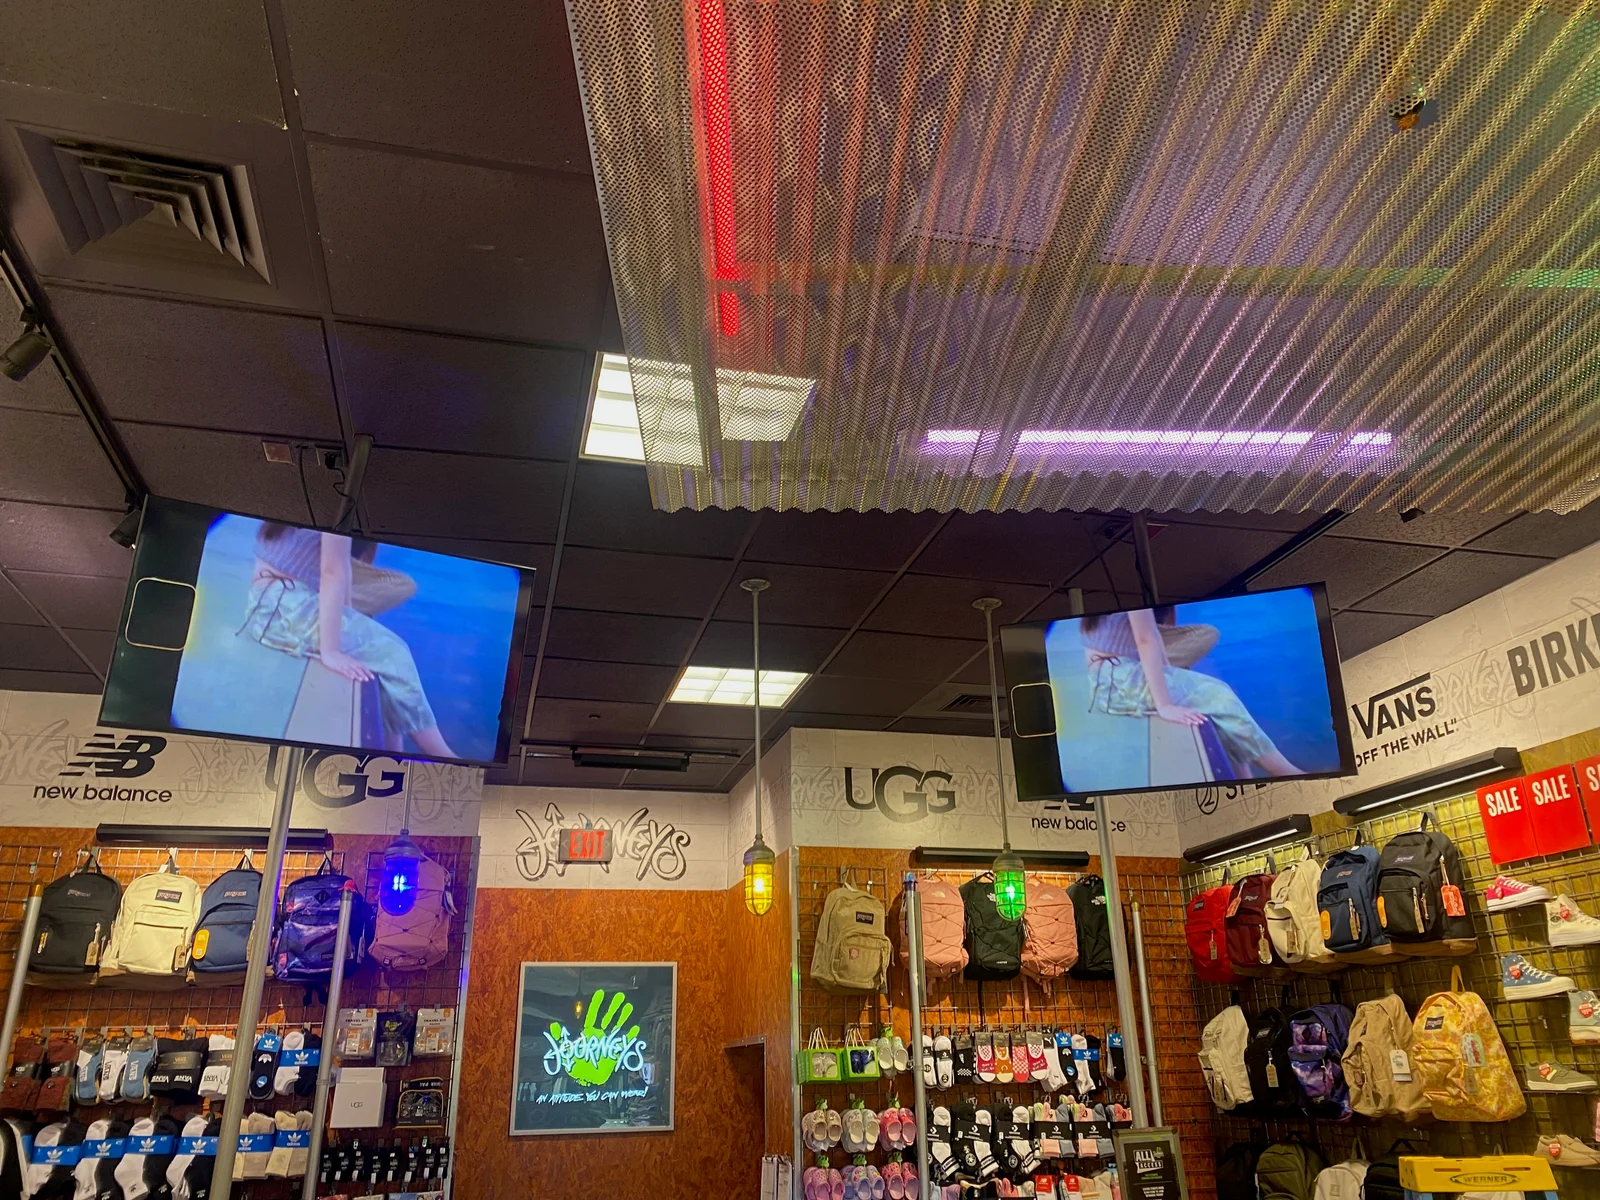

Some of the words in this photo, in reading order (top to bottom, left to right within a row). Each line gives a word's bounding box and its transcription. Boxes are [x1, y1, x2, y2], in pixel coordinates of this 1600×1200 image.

[1351, 672, 1436, 740] VANS
[1381, 737, 1410, 758] THE
[1532, 774, 1571, 806] SALE
[1586, 766, 1600, 792] S
[33, 784, 79, 800] new
[83, 784, 173, 803] balance
[844, 765, 957, 824] UGG
[1485, 787, 1522, 817] SALE
[1031, 816, 1061, 830] new
[1065, 816, 1126, 832] balace
[568, 830, 607, 859] EXIT
[1135, 1150, 1152, 1162] ALL
[1464, 1175, 1507, 1183] WERNER
